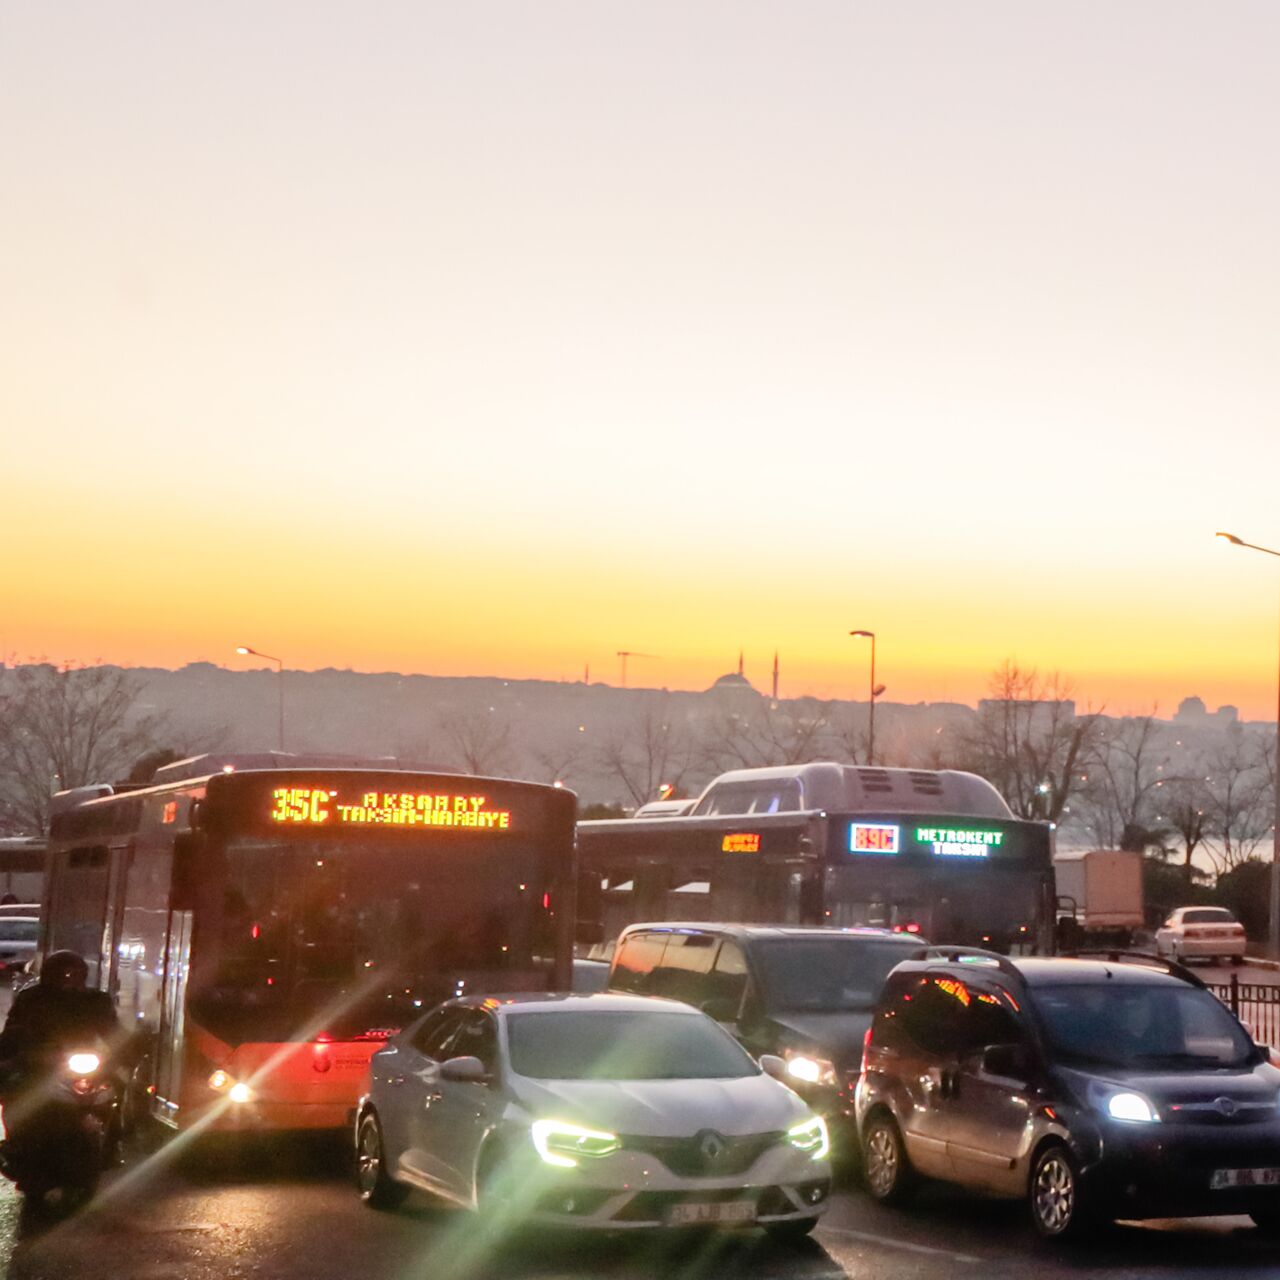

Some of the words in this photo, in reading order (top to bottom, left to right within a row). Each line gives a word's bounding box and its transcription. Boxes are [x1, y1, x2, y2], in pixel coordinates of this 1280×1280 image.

[363, 792, 486, 813] AKSARAY
[855, 826, 894, 850] 89C
[916, 827, 1004, 845] METROKENT
